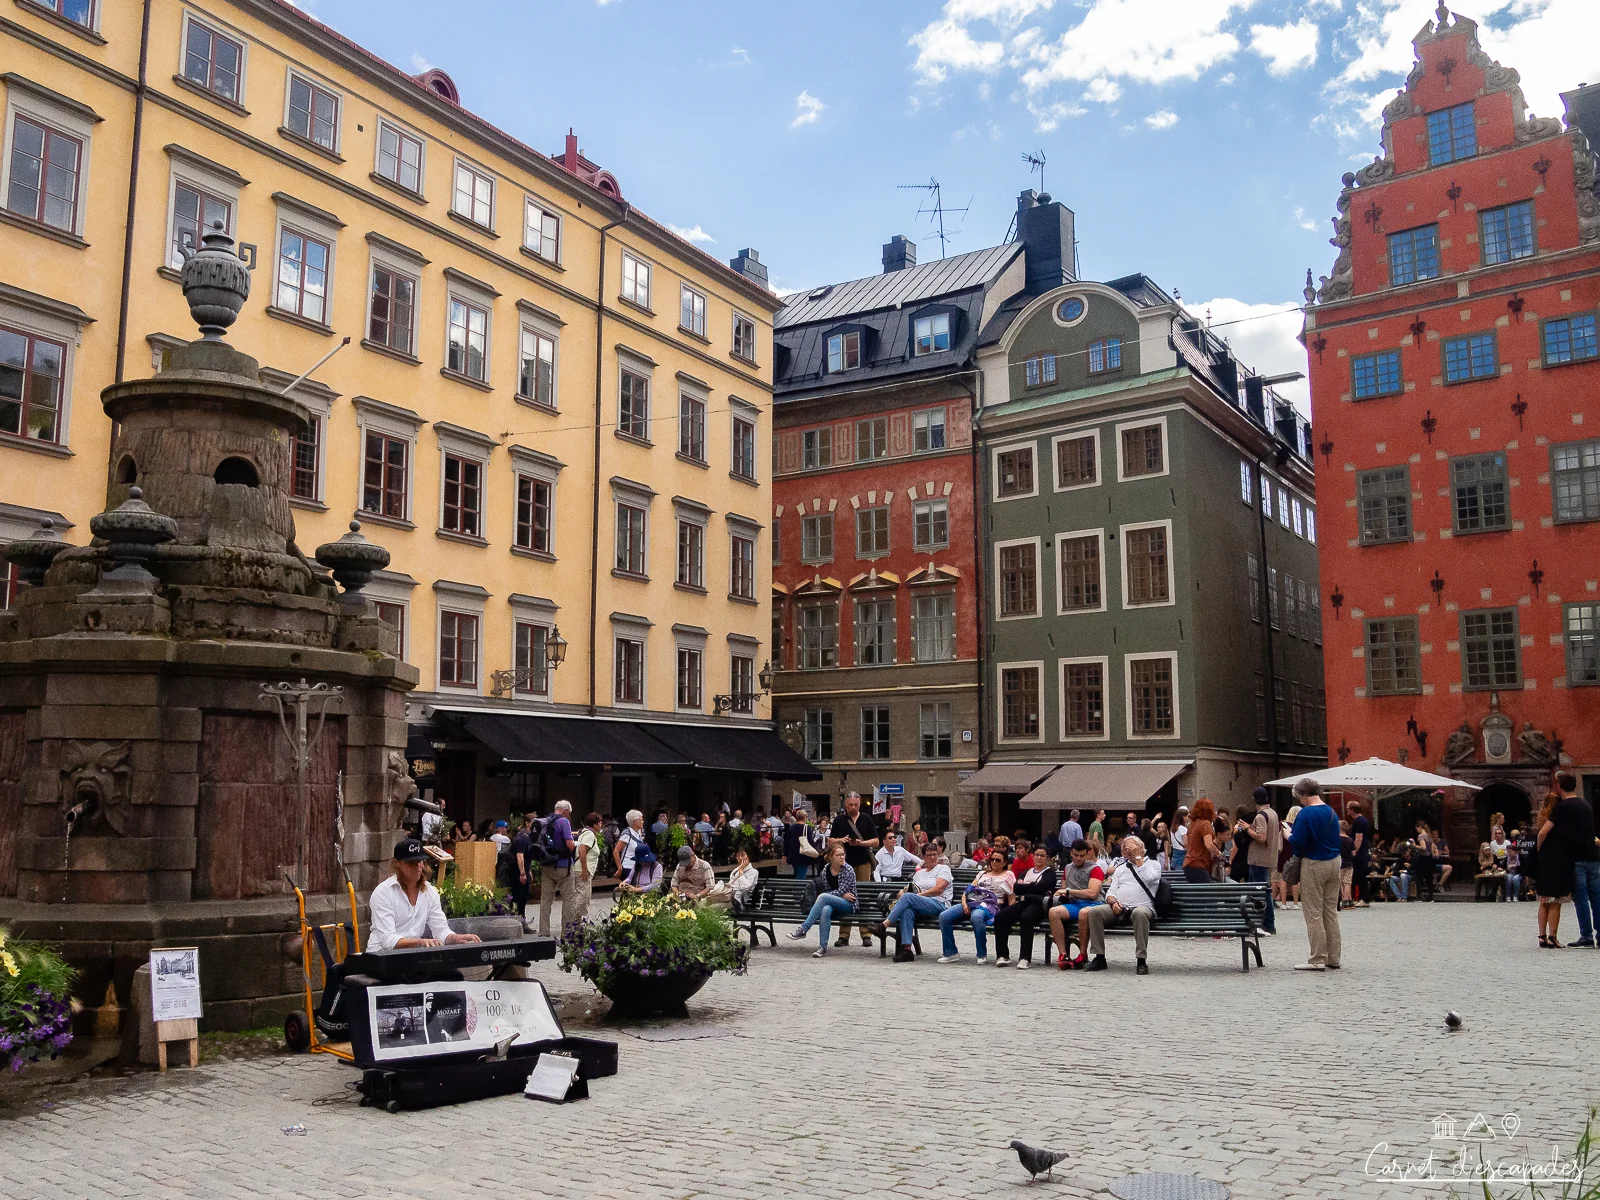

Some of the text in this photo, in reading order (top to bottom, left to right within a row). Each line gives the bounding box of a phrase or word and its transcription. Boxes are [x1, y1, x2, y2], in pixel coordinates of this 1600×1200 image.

[489, 948, 516, 960] YAMAHA
[485, 989, 501, 1001] CD
[436, 1008, 461, 1016] MOZART
